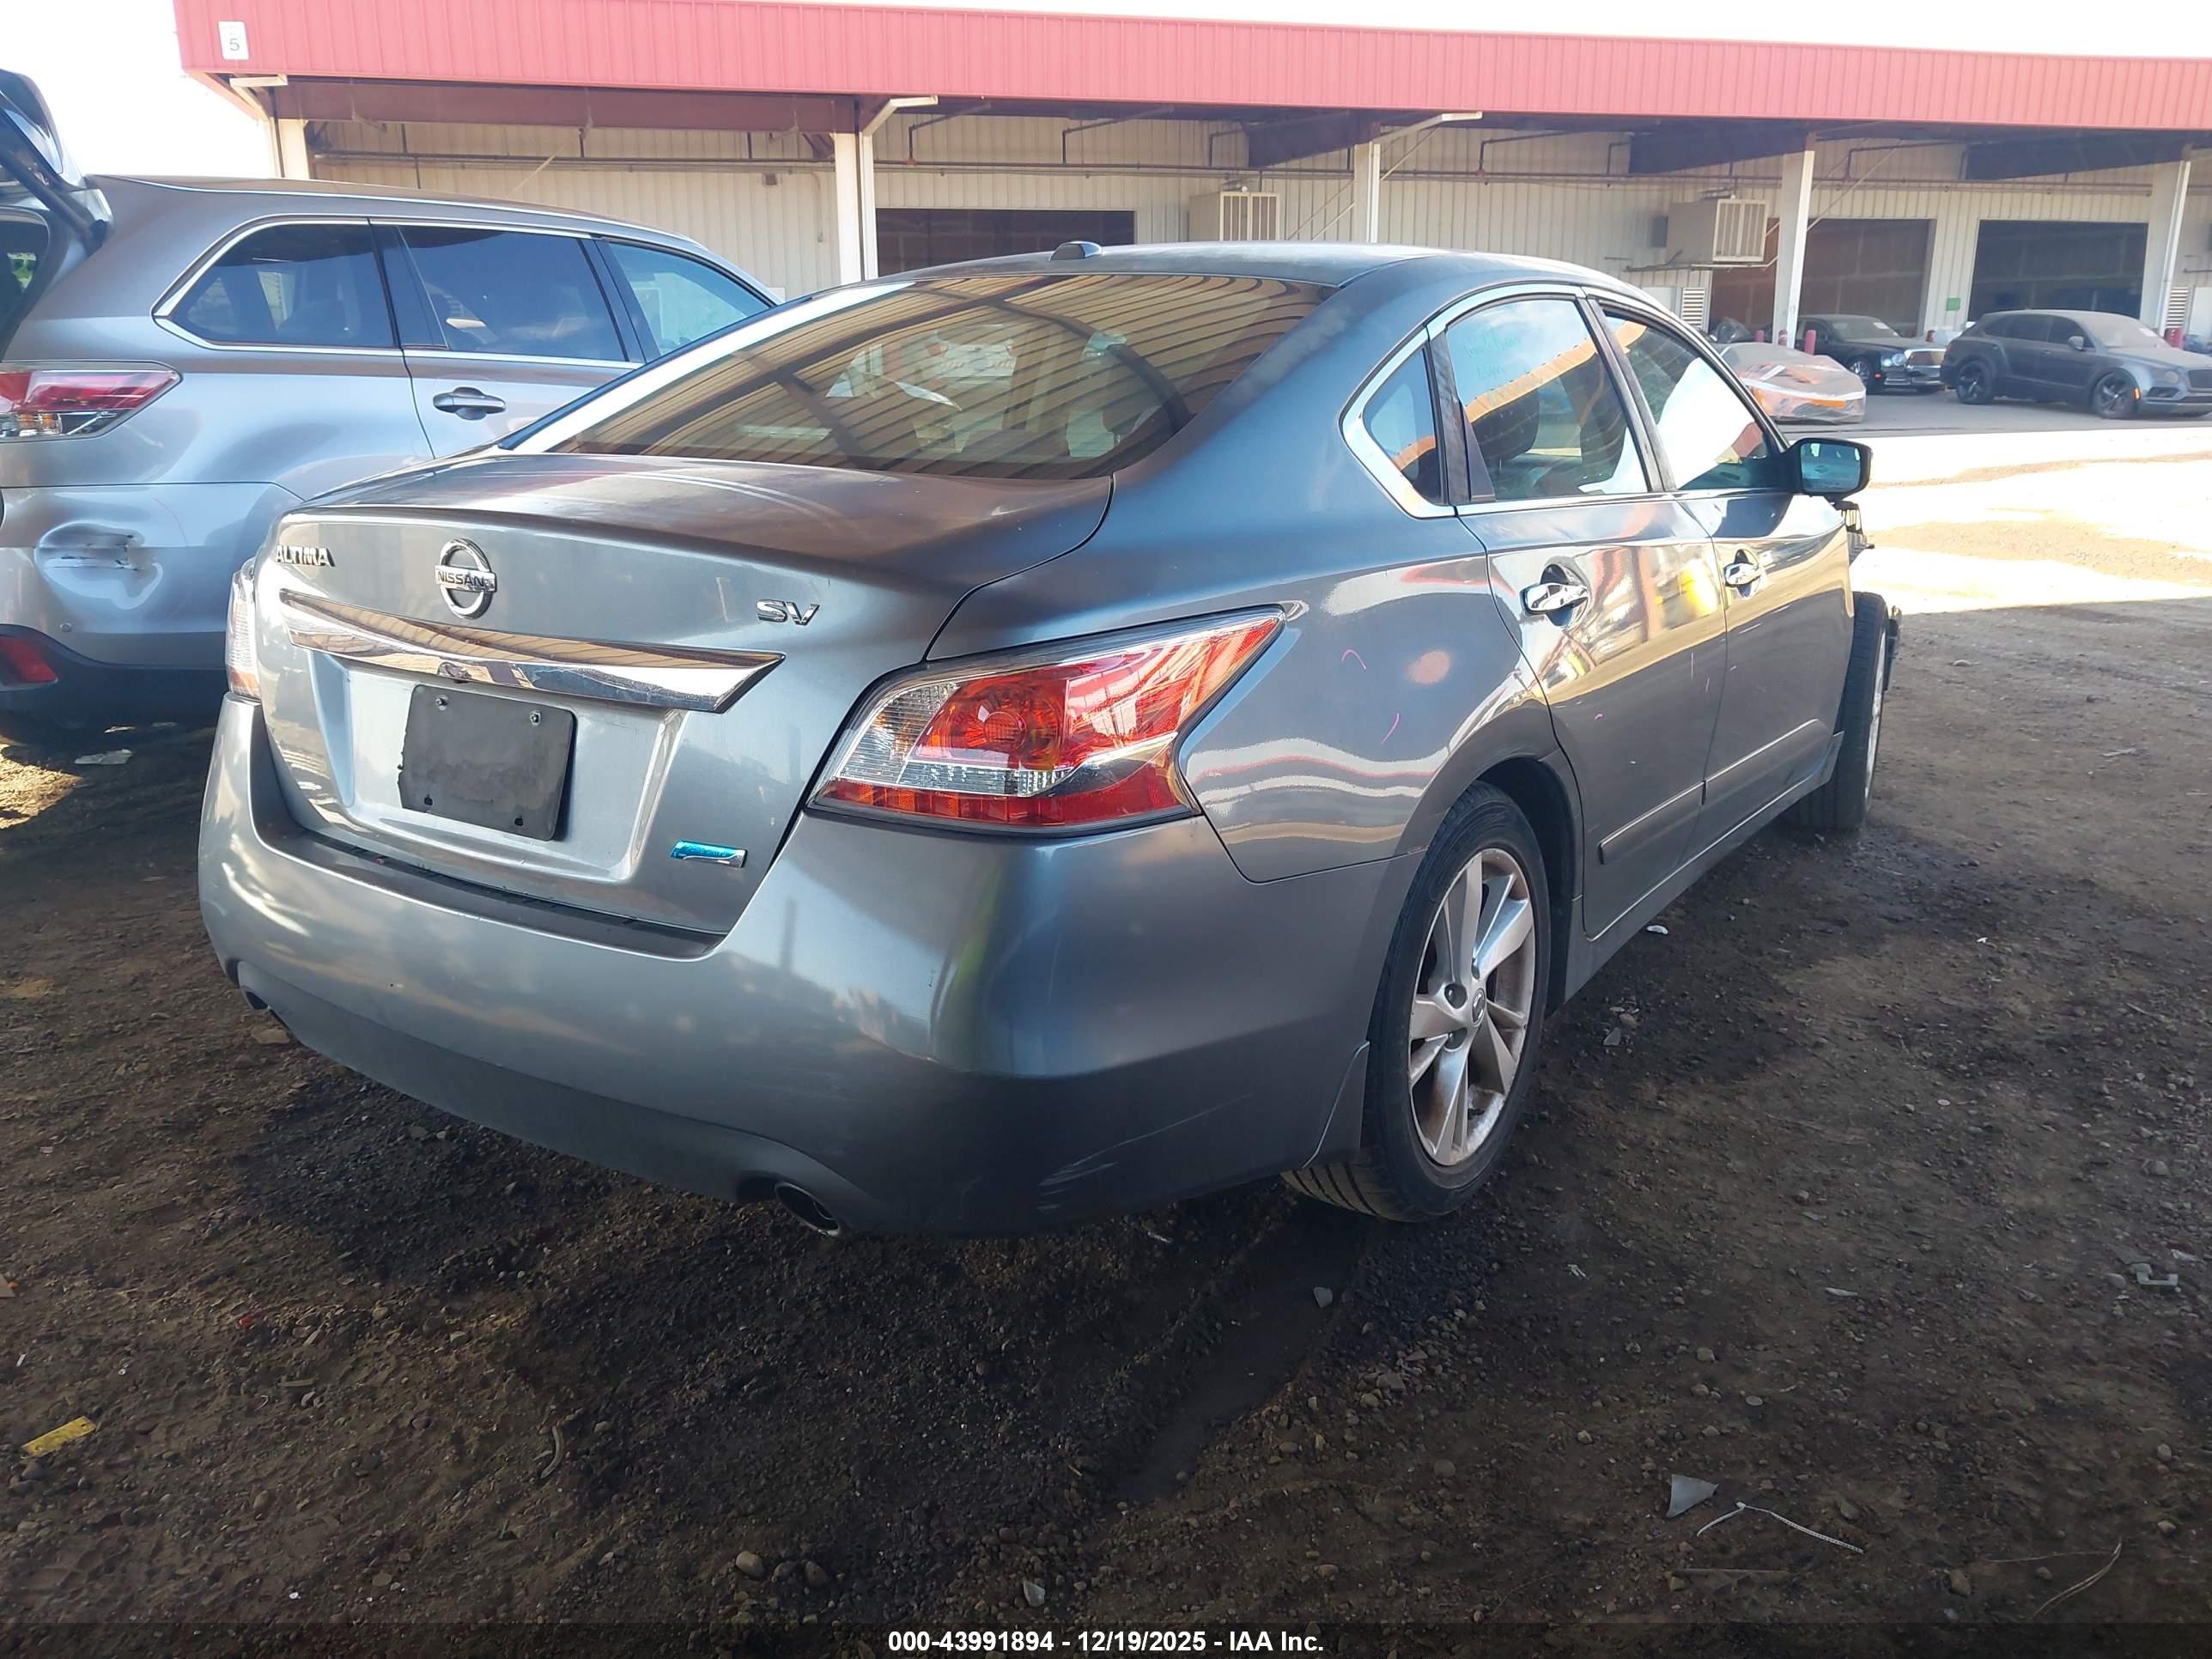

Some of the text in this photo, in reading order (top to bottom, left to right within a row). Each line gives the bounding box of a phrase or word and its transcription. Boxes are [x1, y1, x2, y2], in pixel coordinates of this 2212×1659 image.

[229, 38, 240, 52] 5
[276, 544, 336, 568] ALTIMA
[437, 570, 485, 587] NISSAN
[756, 599, 820, 626] SV
